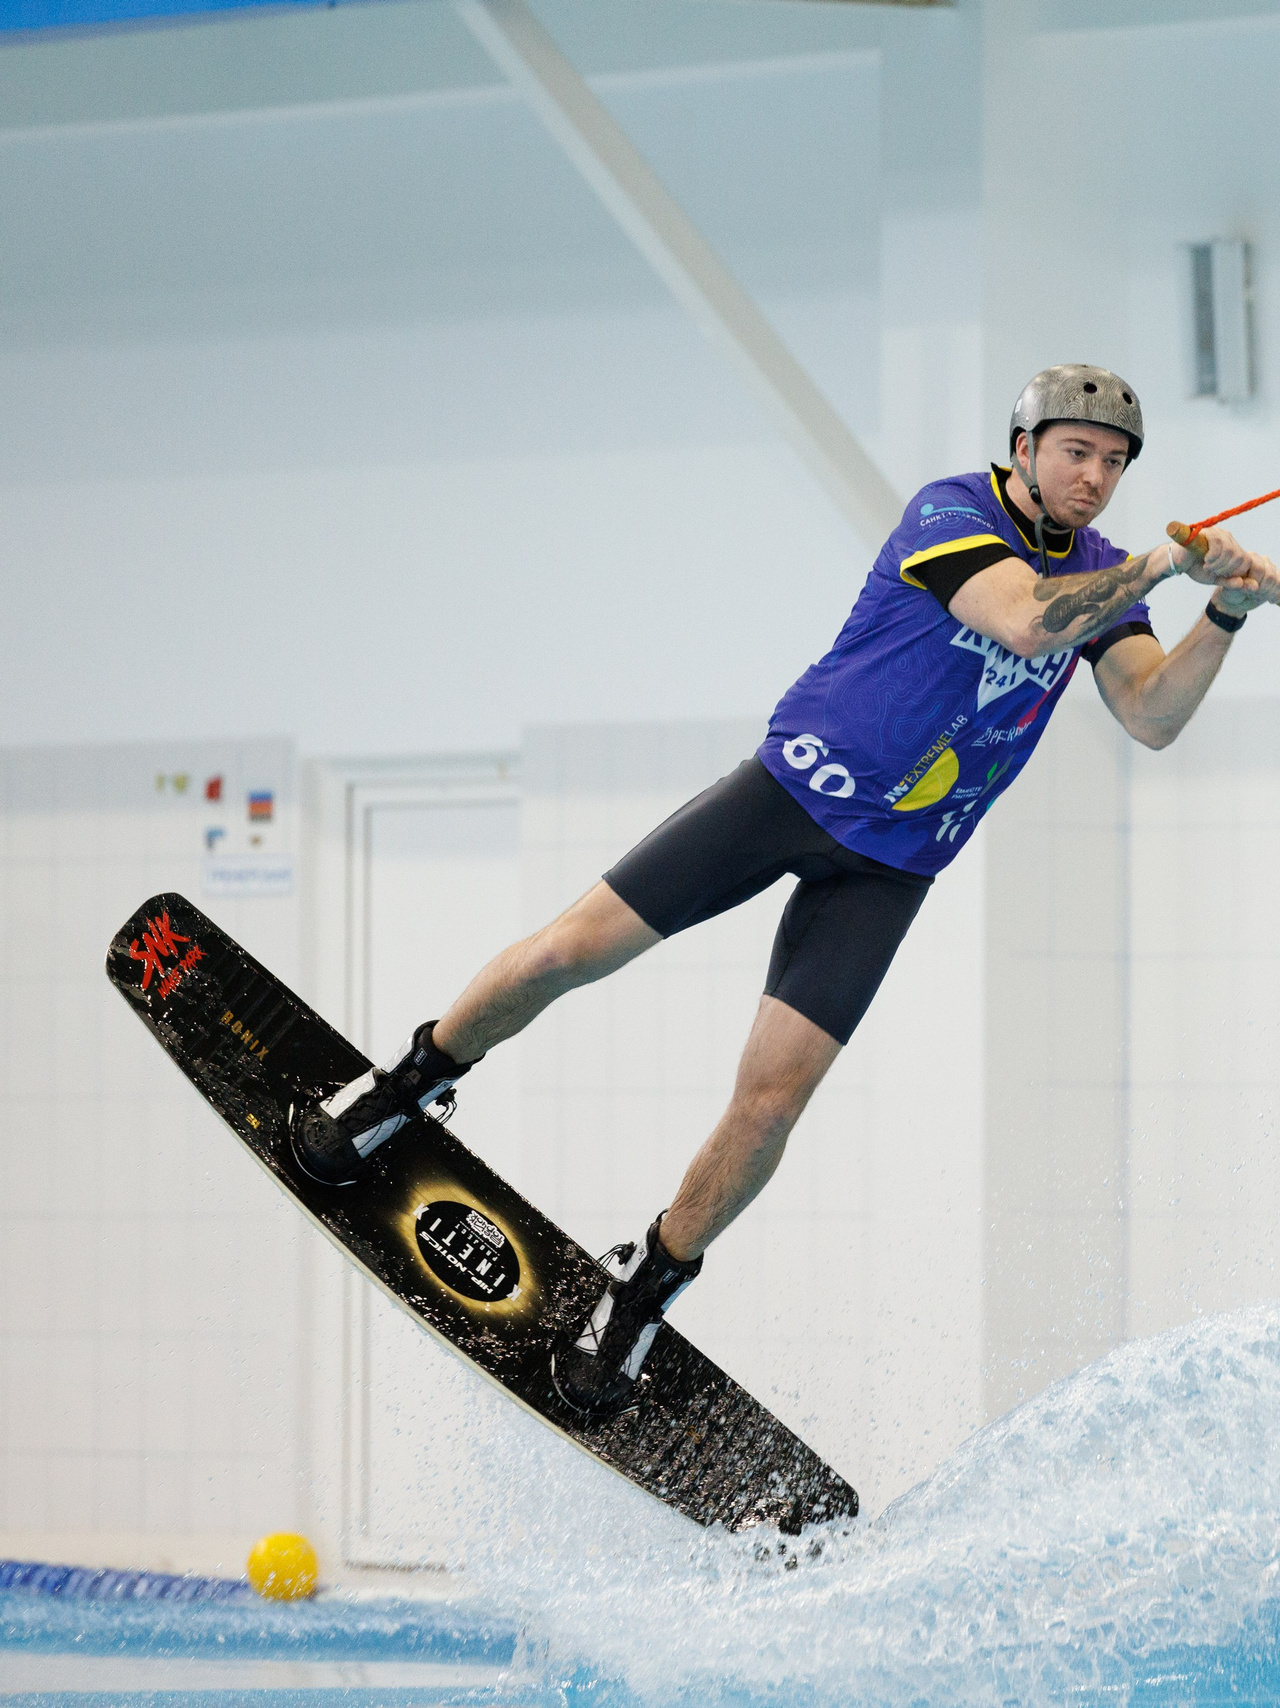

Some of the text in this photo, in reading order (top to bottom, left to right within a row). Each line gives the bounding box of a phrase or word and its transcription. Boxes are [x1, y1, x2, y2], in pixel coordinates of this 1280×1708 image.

[782, 733, 856, 799] 60
[904, 714, 968, 786] EXTREMELAB
[129, 910, 191, 990] SNK
[178, 944, 207, 973] PARK
[221, 1010, 270, 1061] RONIX
[412, 1202, 523, 1301] KINETIK
[454, 1223, 499, 1262] PROJECT
